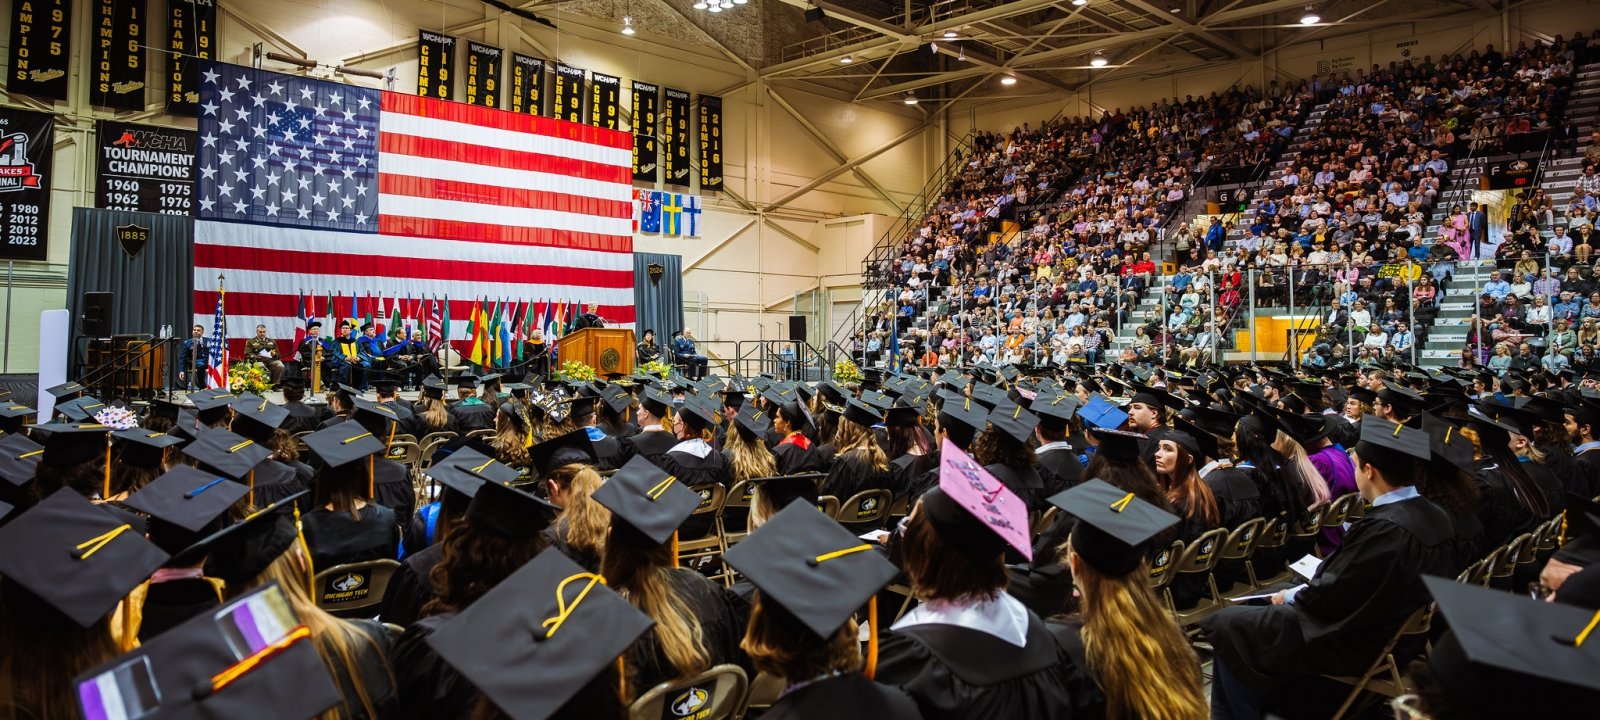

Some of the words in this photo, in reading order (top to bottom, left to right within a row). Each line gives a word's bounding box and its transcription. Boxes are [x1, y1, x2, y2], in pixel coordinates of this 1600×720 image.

[128, 7, 139, 68] 1965
[173, 8, 183, 102] CHAMPIONS
[632, 92, 640, 174] CHAMPIONS
[646, 98, 654, 151] 1974
[126, 129, 186, 151] WCHA
[701, 106, 709, 185] CHAMPIONS
[712, 113, 720, 164] 2016
[104, 146, 195, 166] TOURNAMENT
[109, 160, 190, 178] CHAMPIONS
[106, 180, 139, 192] 1960
[160, 183, 191, 196] 1975
[106, 193, 139, 205] 1962
[160, 196, 191, 208] 1976
[1220, 193, 1227, 202] G
[11, 203, 39, 215] 1980
[9, 214, 38, 225] 2012
[9, 225, 38, 235] 2019
[121, 230, 146, 240] 1885
[8, 235, 37, 246] 2023
